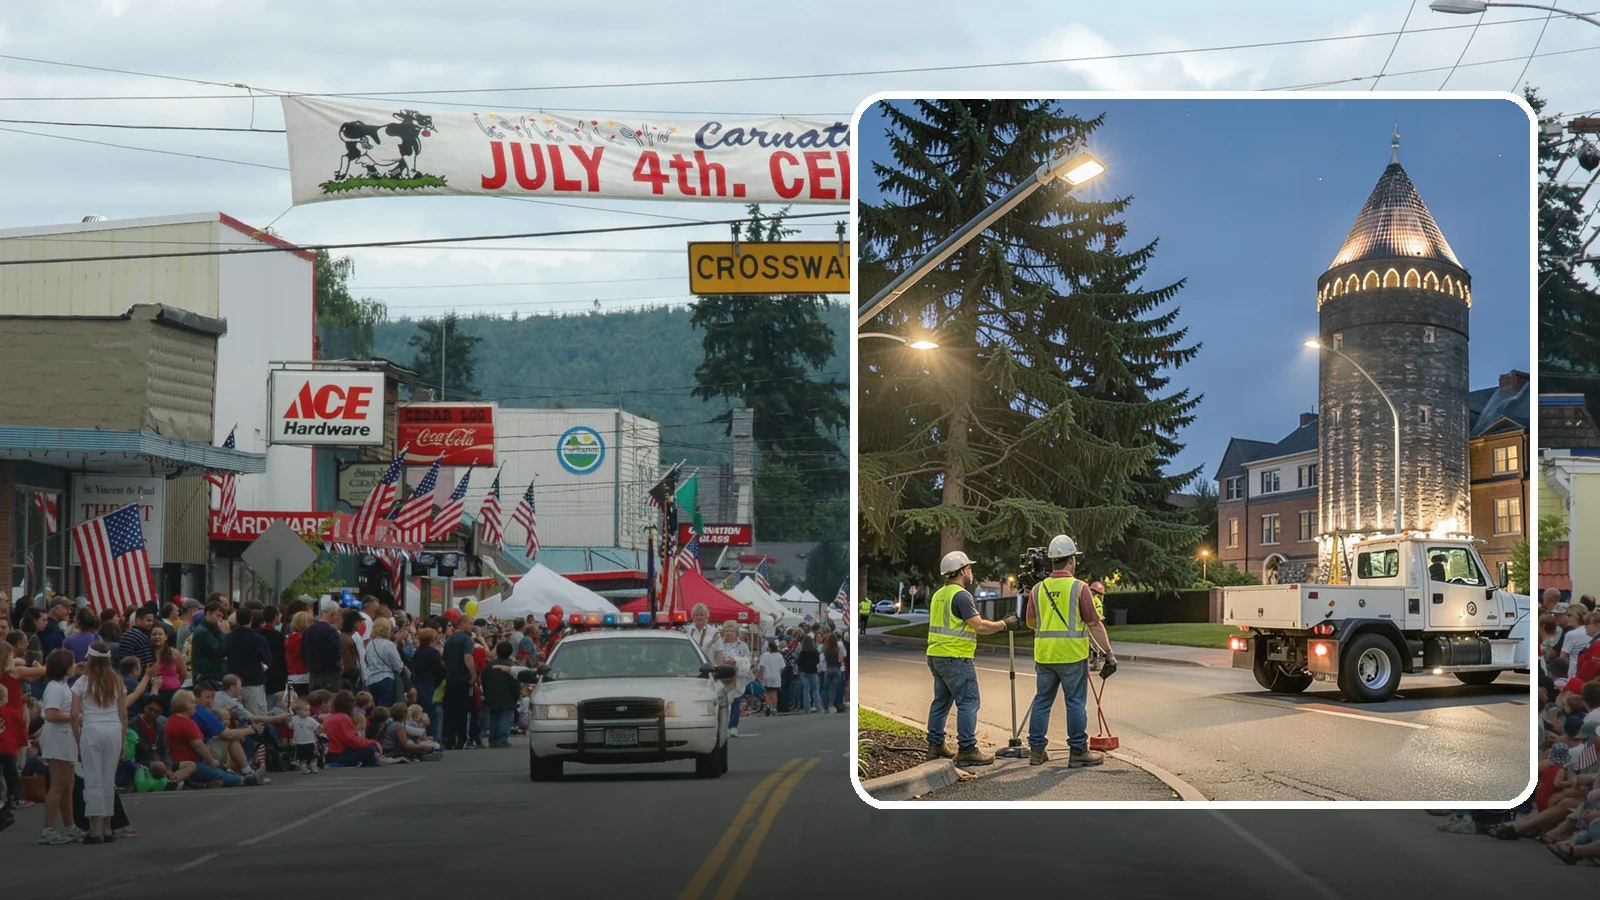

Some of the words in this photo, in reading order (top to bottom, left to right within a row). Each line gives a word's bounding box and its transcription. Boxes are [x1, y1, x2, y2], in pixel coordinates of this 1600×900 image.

[481, 141, 605, 192] JULY
[632, 150, 746, 197] 4th.
[697, 254, 850, 280] CROSSWA
[283, 380, 373, 419] ACE
[405, 410, 452, 422] CEDAR
[461, 410, 485, 421] LOG
[284, 421, 370, 436] Hardware
[95, 485, 124, 494] Vincent
[126, 486, 135, 494] de
[137, 486, 155, 495] Paul
[699, 535, 730, 543] GLASS
